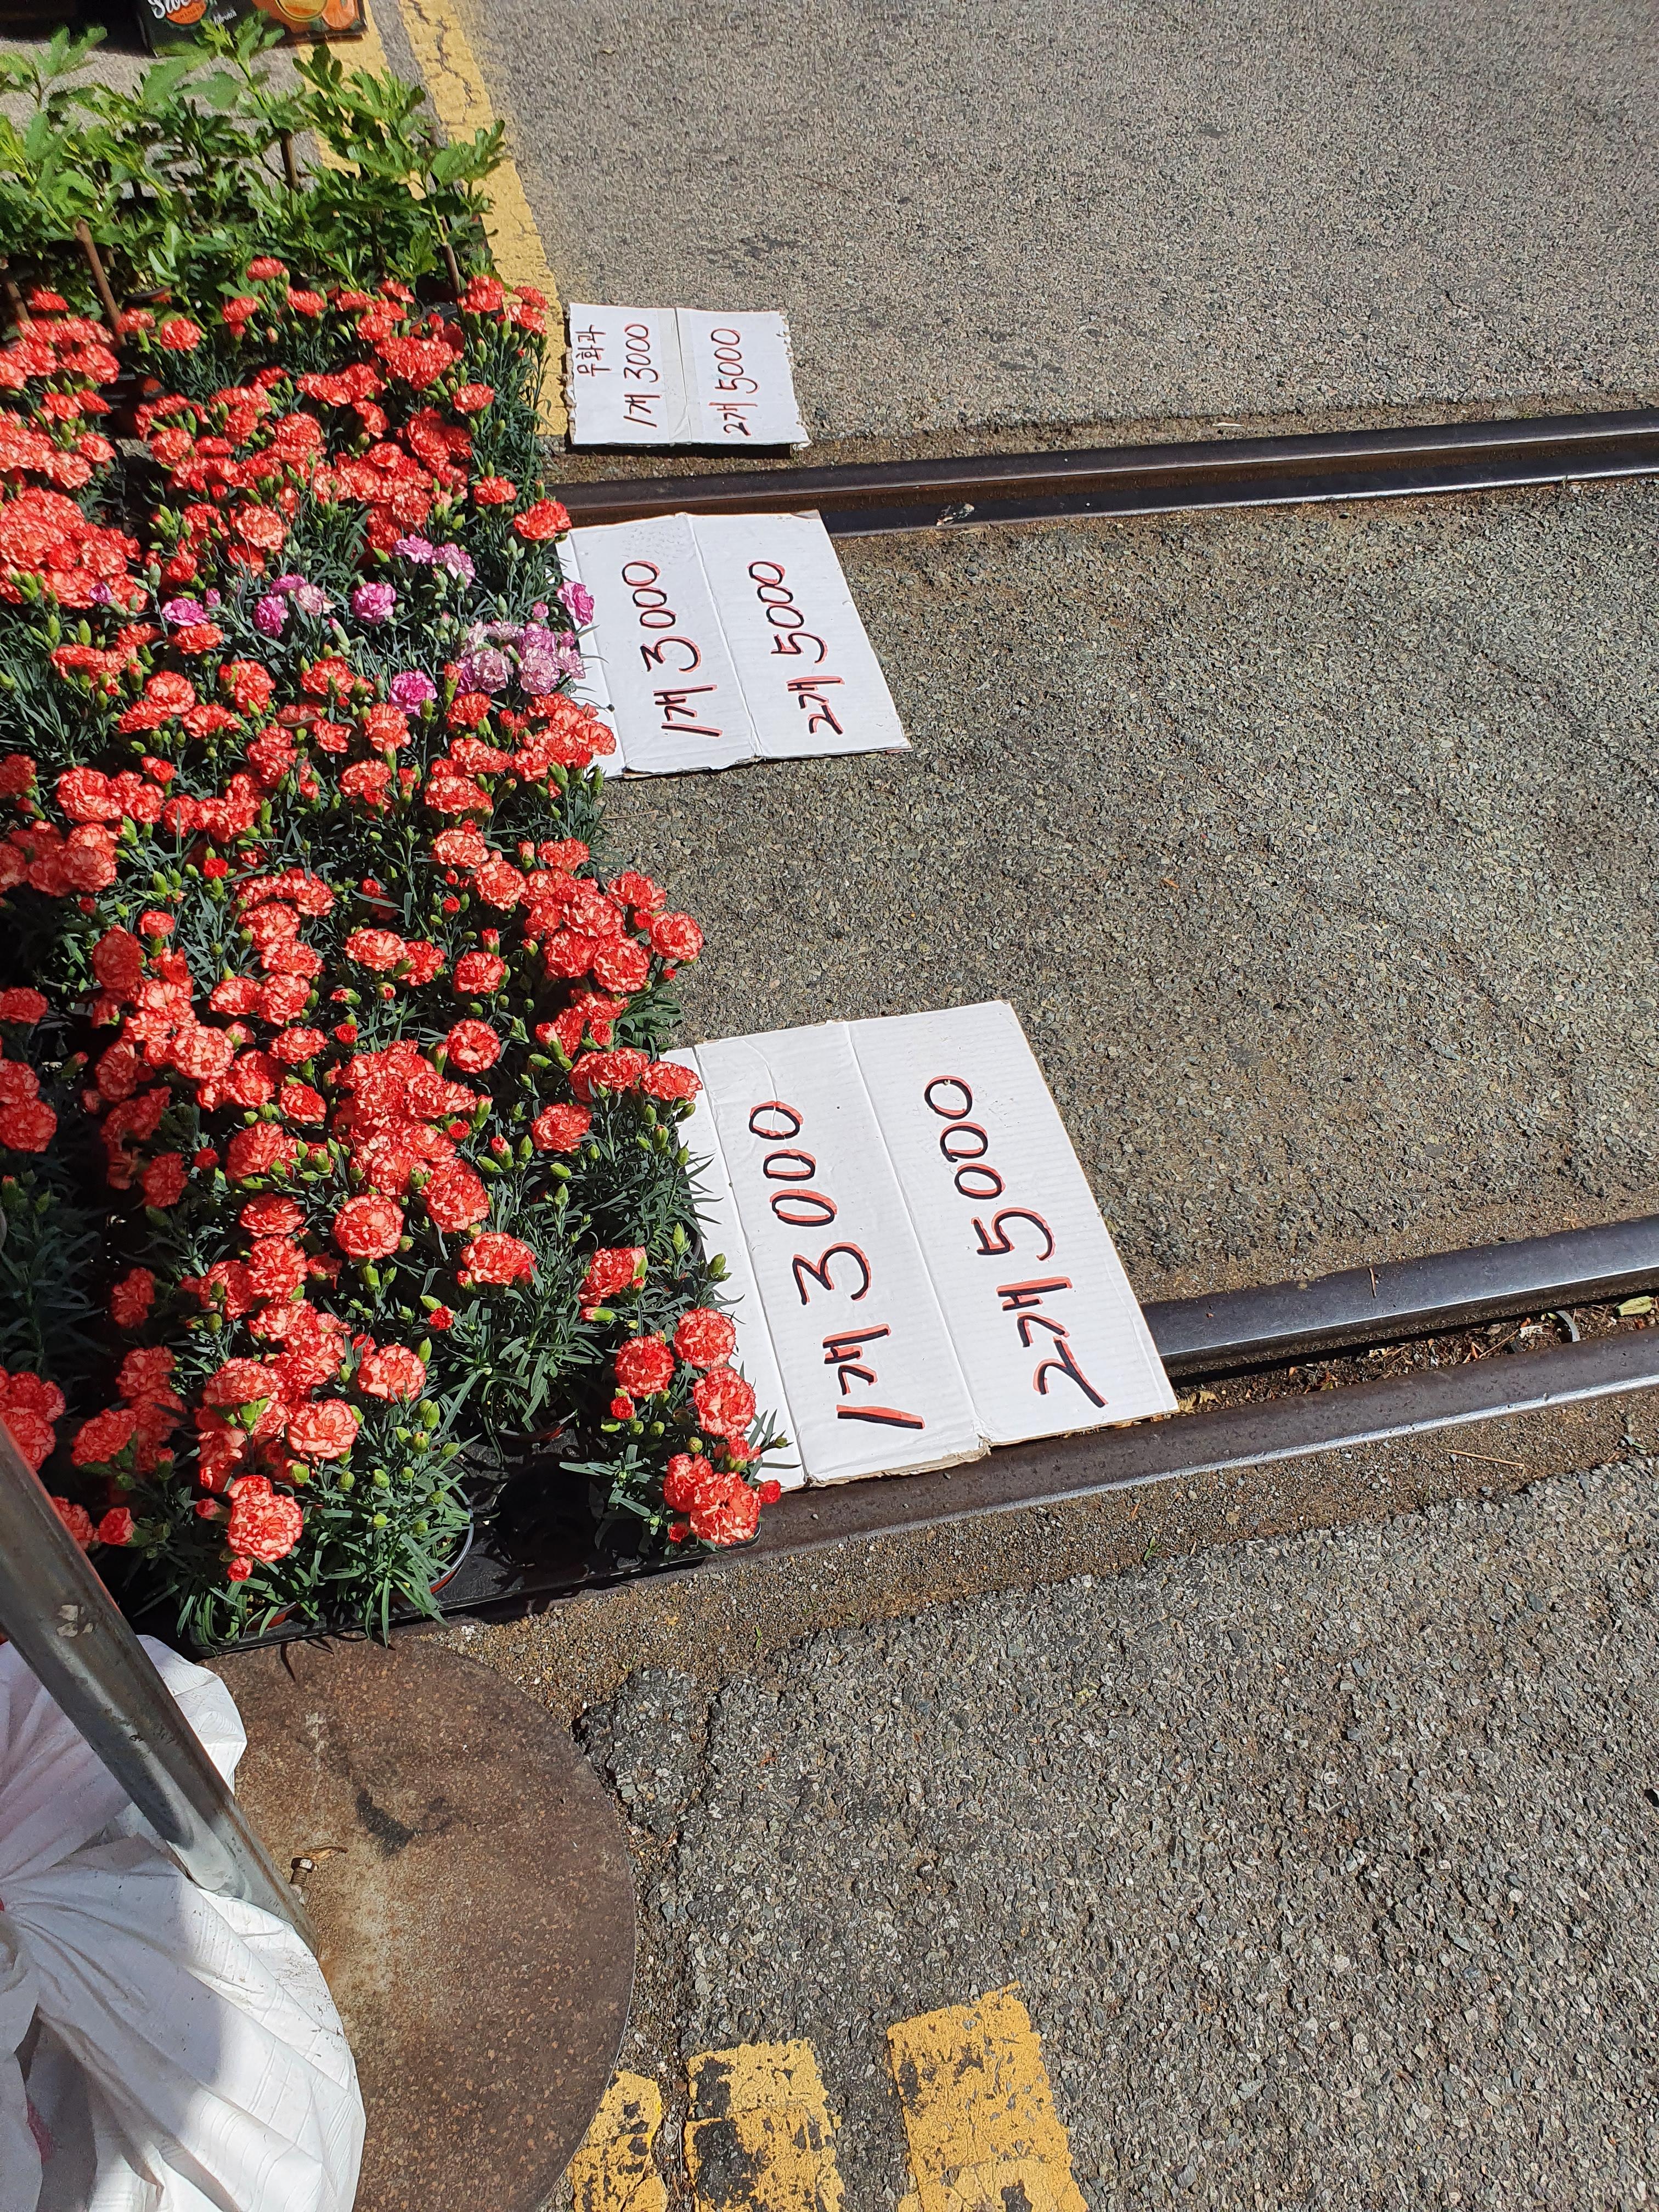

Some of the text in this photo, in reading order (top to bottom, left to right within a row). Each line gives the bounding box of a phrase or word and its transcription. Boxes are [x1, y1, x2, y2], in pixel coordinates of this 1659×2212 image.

[575, 324, 612, 377] 무화과
[623, 323, 662, 428] 1개 3000
[708, 329, 759, 436] 2개 5000
[622, 561, 723, 737] 1개 3000
[748, 561, 845, 735] 2개 5000
[749, 1101, 925, 1430] 1개 3000
[924, 1075, 1109, 1409] 2개 5000
